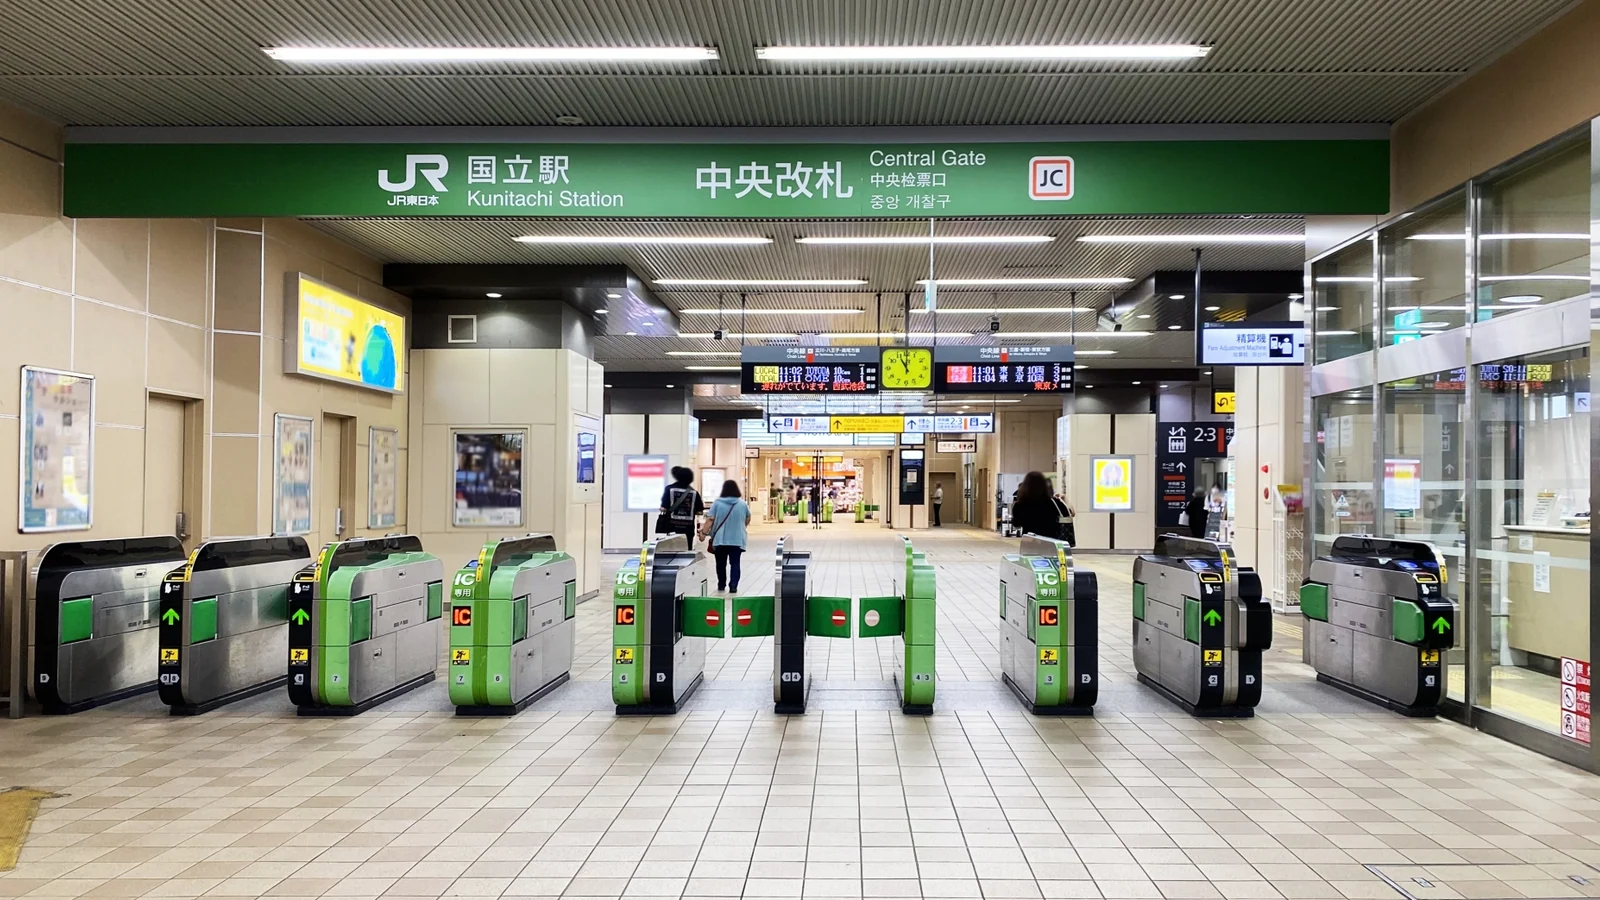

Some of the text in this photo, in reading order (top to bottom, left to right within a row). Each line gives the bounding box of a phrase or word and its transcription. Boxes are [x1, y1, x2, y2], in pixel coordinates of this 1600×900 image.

[870, 150, 986, 166] Central Gate
[378, 154, 449, 192] JR
[468, 154, 570, 185] 国立駅
[696, 161, 854, 199] 中央改札
[870, 173, 946, 188] 中央检票口
[1040, 168, 1064, 188] JC
[387, 195, 439, 206] JR東日本
[468, 190, 624, 206] Kunitachi Station
[870, 194, 952, 210] 중앙 개찰구
[1236, 334, 1266, 344] 精算機
[779, 366, 802, 375] 11:02
[805, 366, 830, 375] TOYODA
[860, 366, 864, 374] 1
[973, 366, 994, 374] 11:01
[1054, 366, 1060, 374] 3
[973, 374, 996, 382] 11:04
[454, 573, 475, 585] IC
[616, 572, 638, 585] IC
[1037, 572, 1058, 585] IC
[455, 588, 471, 597] 専用
[618, 588, 634, 596] 専用
[1040, 588, 1057, 597] 専用
[454, 609, 471, 625] IC
[617, 608, 634, 624] IC
[1040, 609, 1057, 624] IC
